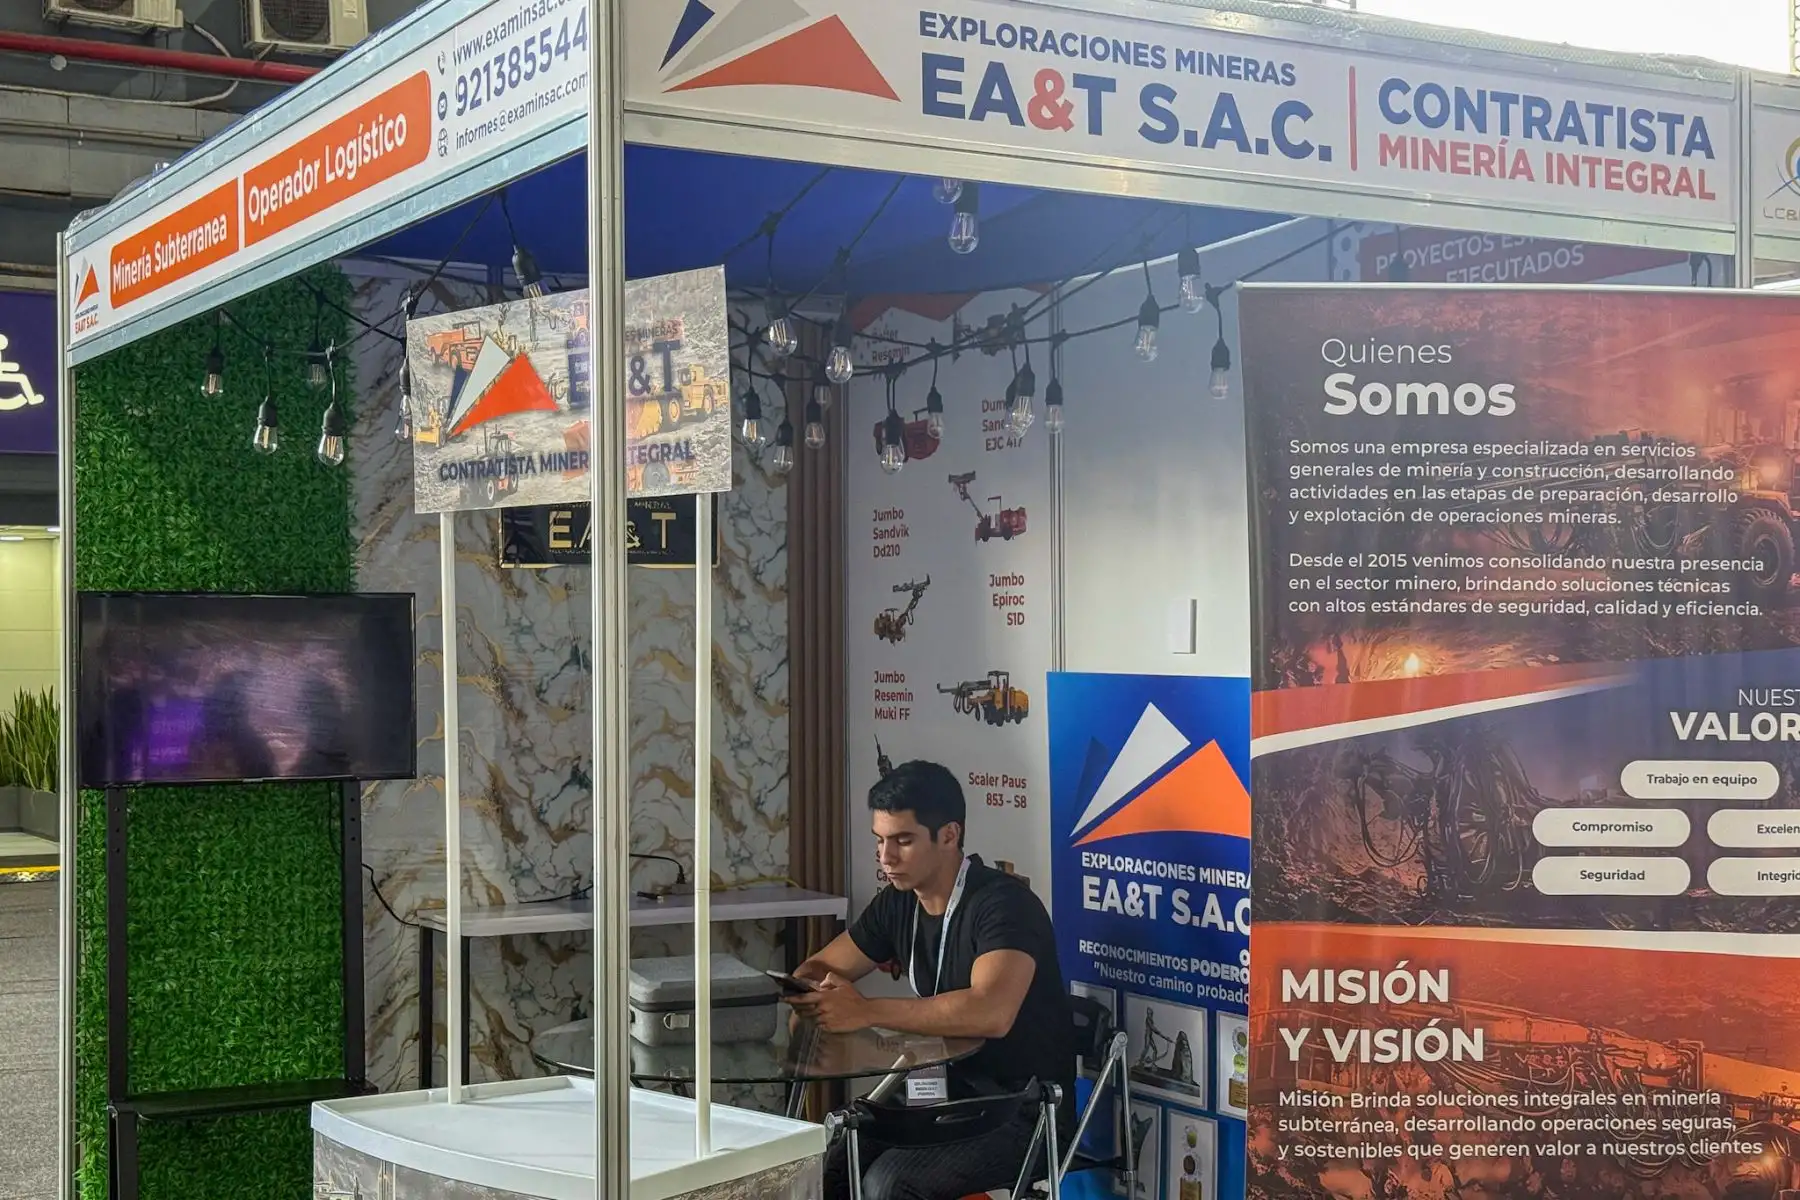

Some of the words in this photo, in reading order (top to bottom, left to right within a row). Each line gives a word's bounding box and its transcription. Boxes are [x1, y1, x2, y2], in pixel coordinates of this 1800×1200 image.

[453, 0, 571, 67] www.examinsac.
[919, 10, 1167, 70] EXPLORACIONES
[1175, 48, 1297, 87] MINERAS
[455, 6, 588, 117] 921385544
[456, 71, 588, 150] informes@examinsac.com
[921, 51, 1117, 137] EA&T
[1138, 82, 1333, 162] S.A.C.
[1378, 77, 1716, 160] CONTRATISTA
[248, 158, 321, 226] Operador
[325, 113, 407, 184] Logístico
[1378, 138, 1536, 183] MINERÍA
[1545, 151, 1717, 201] INTEGRAL
[112, 247, 152, 295] Minería
[153, 213, 228, 273] Subterranea
[1321, 338, 1453, 368] Quienes
[1323, 372, 1517, 417] Somos
[1289, 439, 1350, 455] Somos
[1354, 443, 1385, 455] una
[1391, 443, 1468, 458] empresa
[1472, 440, 1589, 458] especializada
[1593, 444, 1616, 456] en
[1620, 443, 1696, 457] servicios
[439, 455, 537, 482] CONTRATISTA
[1289, 462, 1374, 479] generales
[1378, 462, 1401, 477] de
[1406, 462, 1473, 477] minería
[1476, 465, 1488, 481] y
[1491, 463, 1609, 481] construcción,
[1614, 465, 1735, 480] desarrollando
[1289, 485, 1388, 500] actividades
[1393, 488, 1416, 500] en
[1422, 485, 1446, 500] las
[1450, 487, 1507, 503] etapas
[1511, 486, 1535, 501] de
[1539, 486, 1648, 505] preparación,
[1652, 488, 1738, 503] desarrollo
[872, 507, 904, 523] Jumbo
[1288, 510, 1299, 525] y
[1303, 507, 1405, 525] explotación
[1410, 508, 1434, 522] de
[1438, 508, 1544, 525] operaciones
[1548, 509, 1622, 525] mineras.
[872, 526, 910, 541] Sandvik
[1289, 553, 1344, 568] Desde
[1348, 553, 1363, 568] el
[1367, 553, 1407, 568] 2015
[1412, 553, 1484, 569] venimos
[1488, 553, 1606, 570] consolidando
[1611, 556, 1676, 570] nuestra
[1680, 556, 1764, 573] presencia
[989, 573, 1025, 588] Jumbo
[1288, 578, 1311, 590] en
[1315, 576, 1331, 590] el
[1335, 577, 1390, 591] sector
[1395, 576, 1461, 592] minero,
[1465, 576, 1557, 592] brindando
[1561, 576, 1654, 593] soluciones
[1657, 577, 1731, 594] técnicas
[992, 593, 1025, 608] Epiroc
[1288, 601, 1320, 613] con
[1325, 598, 1366, 613] altos
[1370, 598, 1467, 613] estándares
[1471, 599, 1493, 613] de
[1498, 600, 1590, 617] seguridad,
[1594, 600, 1658, 615] calidad
[1662, 604, 1672, 618] y
[1675, 600, 1763, 617] eficiencia.
[874, 670, 906, 684] Jumbo
[874, 689, 914, 702] Resemin
[874, 707, 897, 720] Muki
[899, 708, 911, 721] FF
[968, 772, 1000, 790] Scaler
[1002, 774, 1028, 789] Paus
[1646, 773, 1690, 787] Trabajo
[1692, 776, 1709, 785] en
[1712, 774, 1758, 787] equipo
[986, 792, 1005, 806] 853
[1571, 820, 1654, 834] Compromiso
[1081, 851, 1196, 881] EXPLORACIONES
[1579, 869, 1646, 883] Seguridad
[1082, 874, 1163, 920] EA&T
[1079, 939, 1189, 972] RECONOCIMIENTOS
[1149, 975, 1194, 994] camino
[1281, 960, 1450, 1005] MISIÓN
[1278, 1027, 1312, 1062] Y
[1322, 1018, 1485, 1064] VISIÓN
[1278, 1090, 1344, 1108] Misión
[1350, 1091, 1411, 1108] Brinda
[1416, 1090, 1519, 1107] soluciones
[1524, 1090, 1617, 1109] integrales
[1621, 1094, 1646, 1106] en
[1652, 1089, 1721, 1106] minería
[1278, 1116, 1400, 1135] subterránea,
[1404, 1115, 1536, 1132] desarrollando
[1541, 1116, 1657, 1134] operaciones
[1661, 1116, 1737, 1134] seguras,
[1277, 1145, 1290, 1160] y
[1294, 1142, 1403, 1158] sostenibles
[1407, 1145, 1443, 1160] que
[1448, 1144, 1530, 1160] generen
[1535, 1140, 1582, 1157] valor
[1586, 1144, 1597, 1156] a
[1602, 1141, 1686, 1156] nuestros
[1689, 1139, 1763, 1155] clientes
